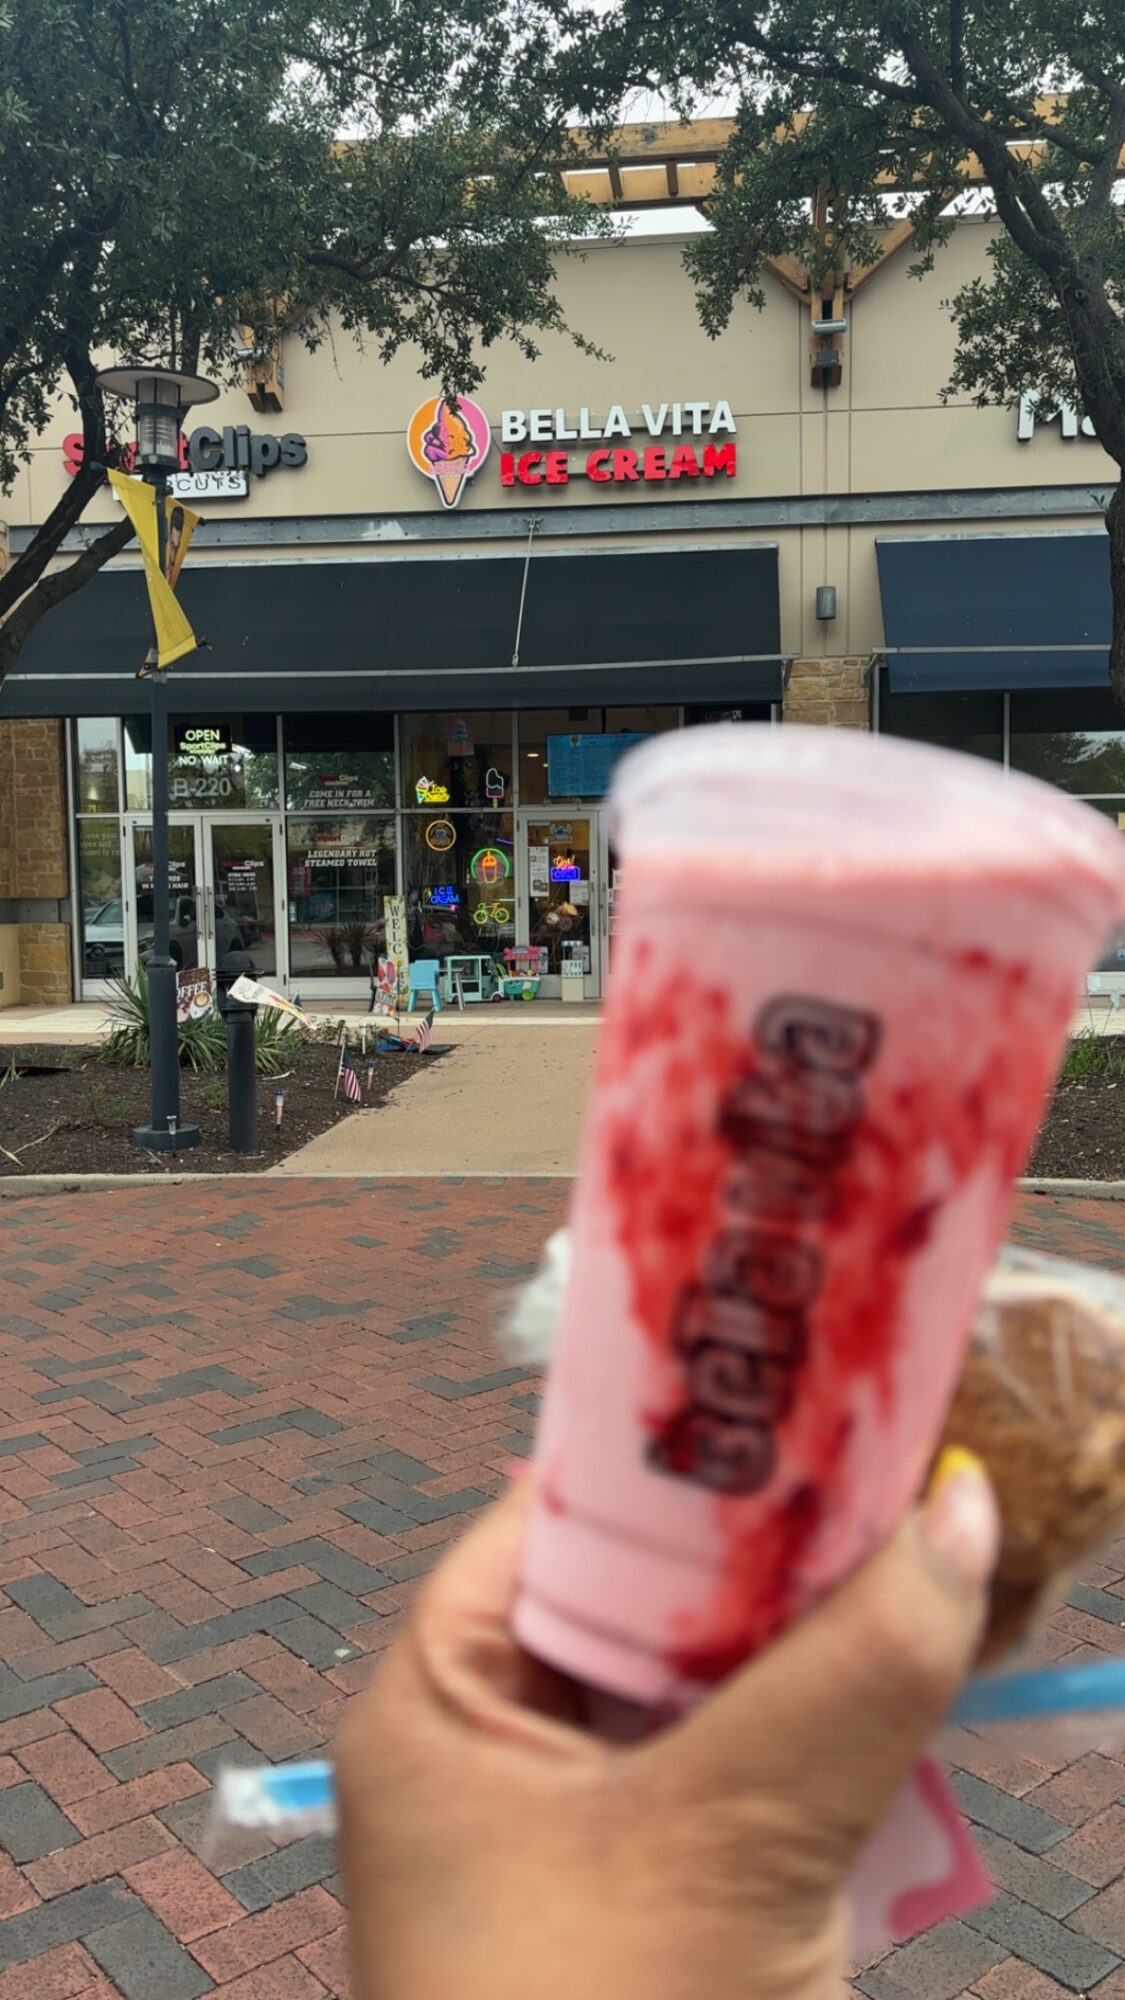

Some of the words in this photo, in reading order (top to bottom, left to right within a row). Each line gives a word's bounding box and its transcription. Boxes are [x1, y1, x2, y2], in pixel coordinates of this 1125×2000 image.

[502, 405, 632, 443] BELLA
[641, 400, 737, 437] VITA
[501, 450, 570, 487] ICE
[586, 443, 737, 483] CREAM
[185, 729, 221, 741] OPEN
[179, 755, 197, 766] NO
[201, 754, 229, 766] WAIT
[173, 777, 232, 798] B-220
[309, 790, 334, 798] COME
[335, 790, 346, 798] IN
[346, 790, 363, 798] FOR
[365, 789, 372, 797] A
[304, 799, 327, 808] FREE
[308, 850, 358, 859] LEGENDARY
[304, 859, 345, 868] STEAMED
[346, 858, 377, 867] TOWEL
[434, 886, 454, 895] ICE
[430, 895, 460, 904] CREAM
